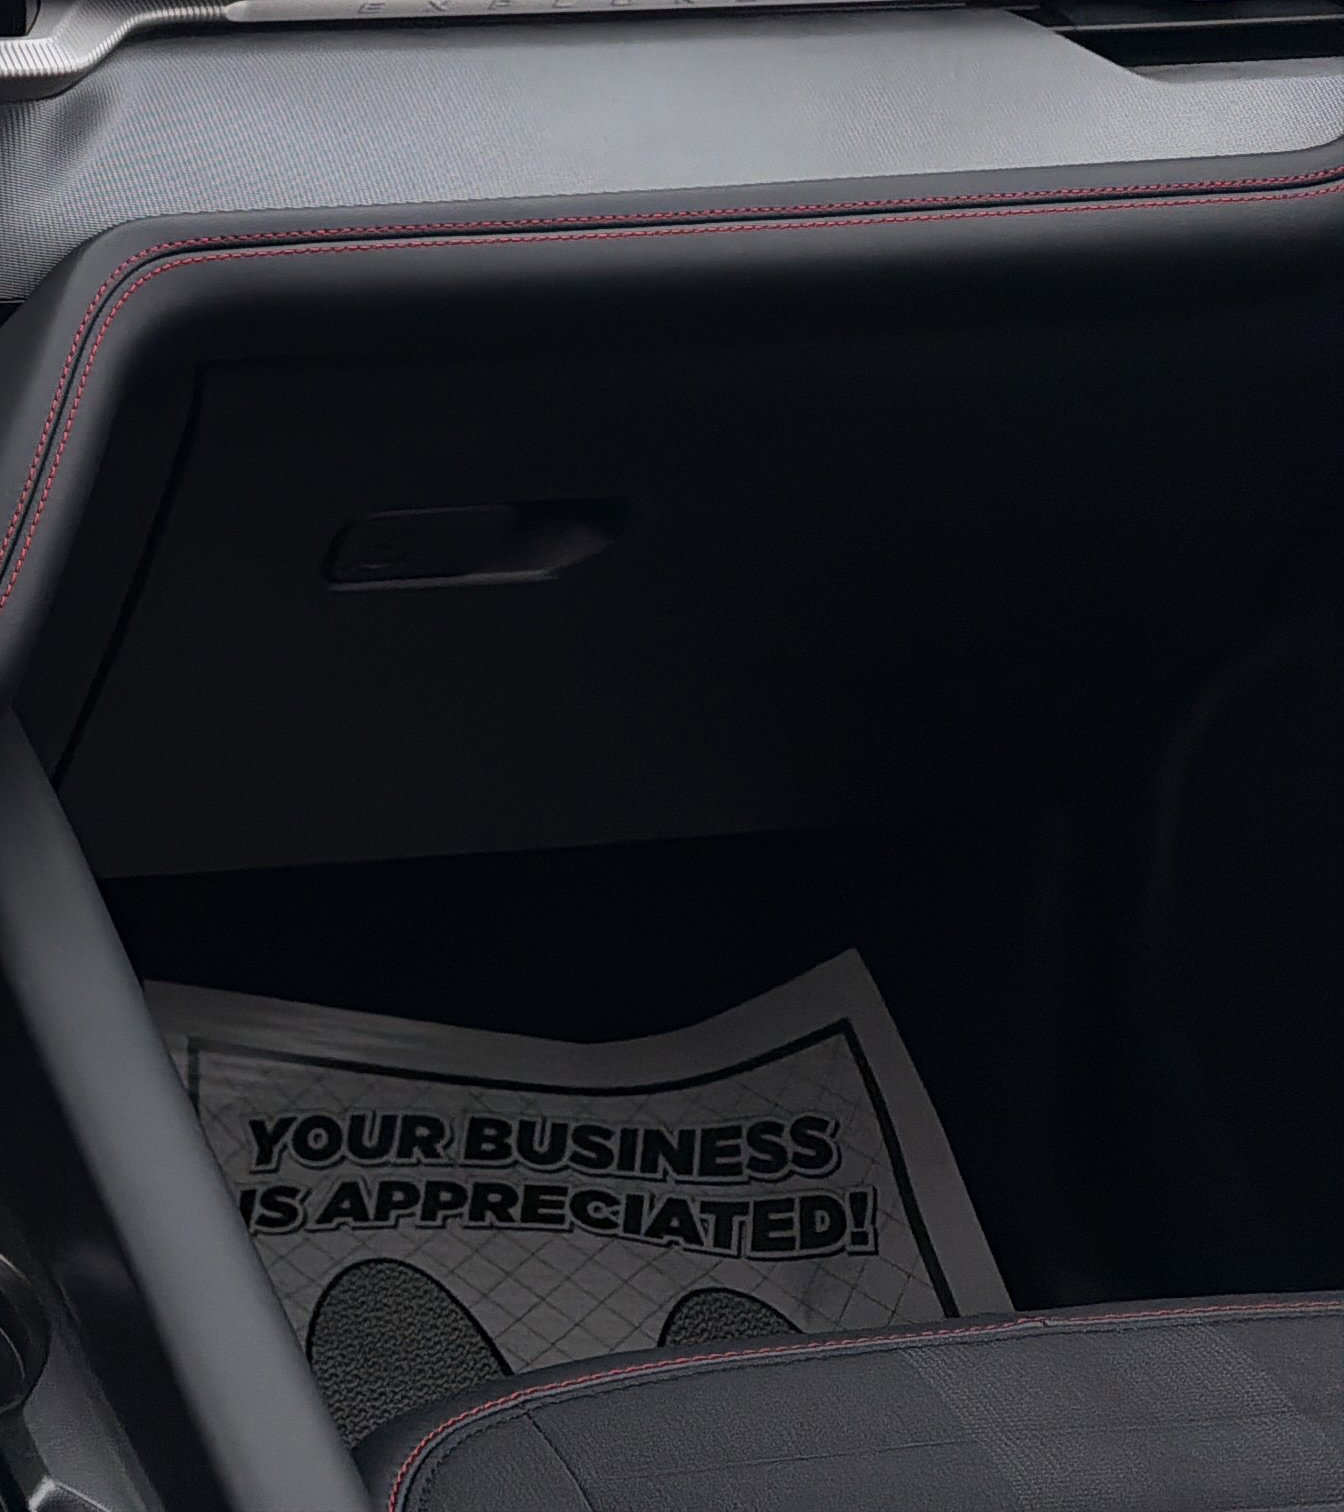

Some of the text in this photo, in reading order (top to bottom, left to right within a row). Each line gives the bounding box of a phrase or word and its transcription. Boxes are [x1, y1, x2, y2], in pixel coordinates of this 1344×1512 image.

[250, 1112, 841, 1182] YOUR BUSINESS
[240, 1179, 879, 1257] IS APPRECIATED!
